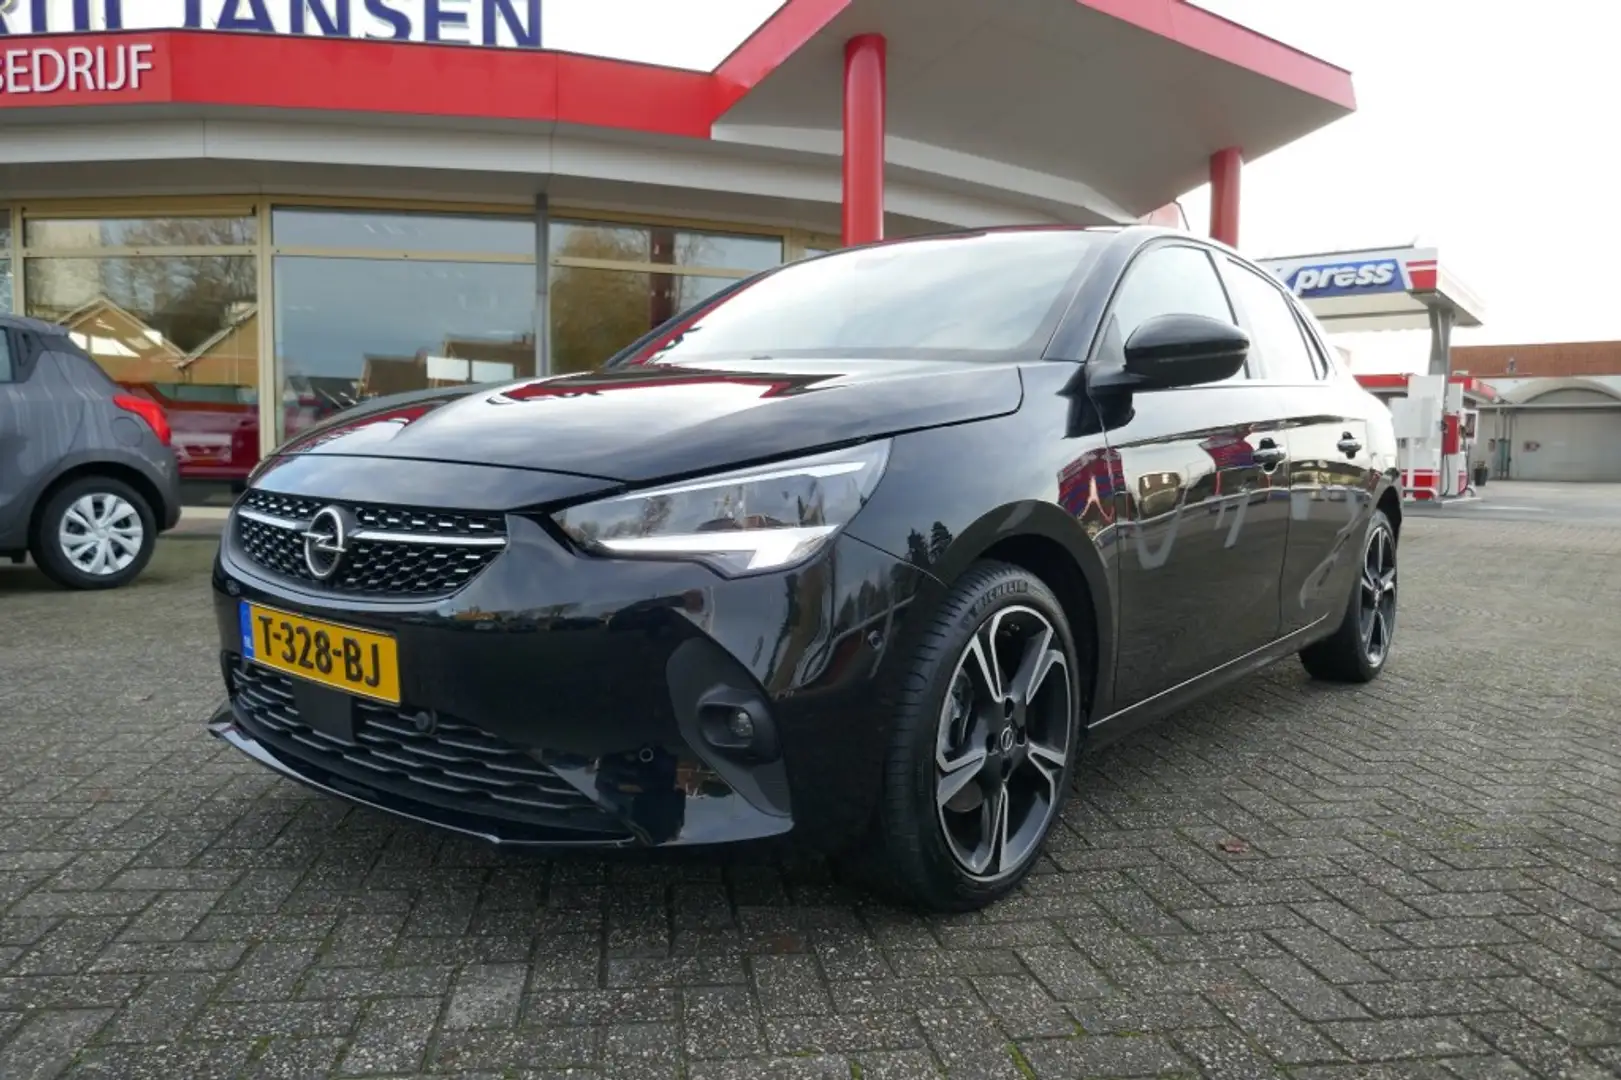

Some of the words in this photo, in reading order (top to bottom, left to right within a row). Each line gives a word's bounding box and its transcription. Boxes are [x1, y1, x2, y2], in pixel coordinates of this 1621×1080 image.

[0, 44, 153, 93] EDRIJF
[1286, 263, 1396, 297] press
[258, 615, 380, 688] T-328-BJ
